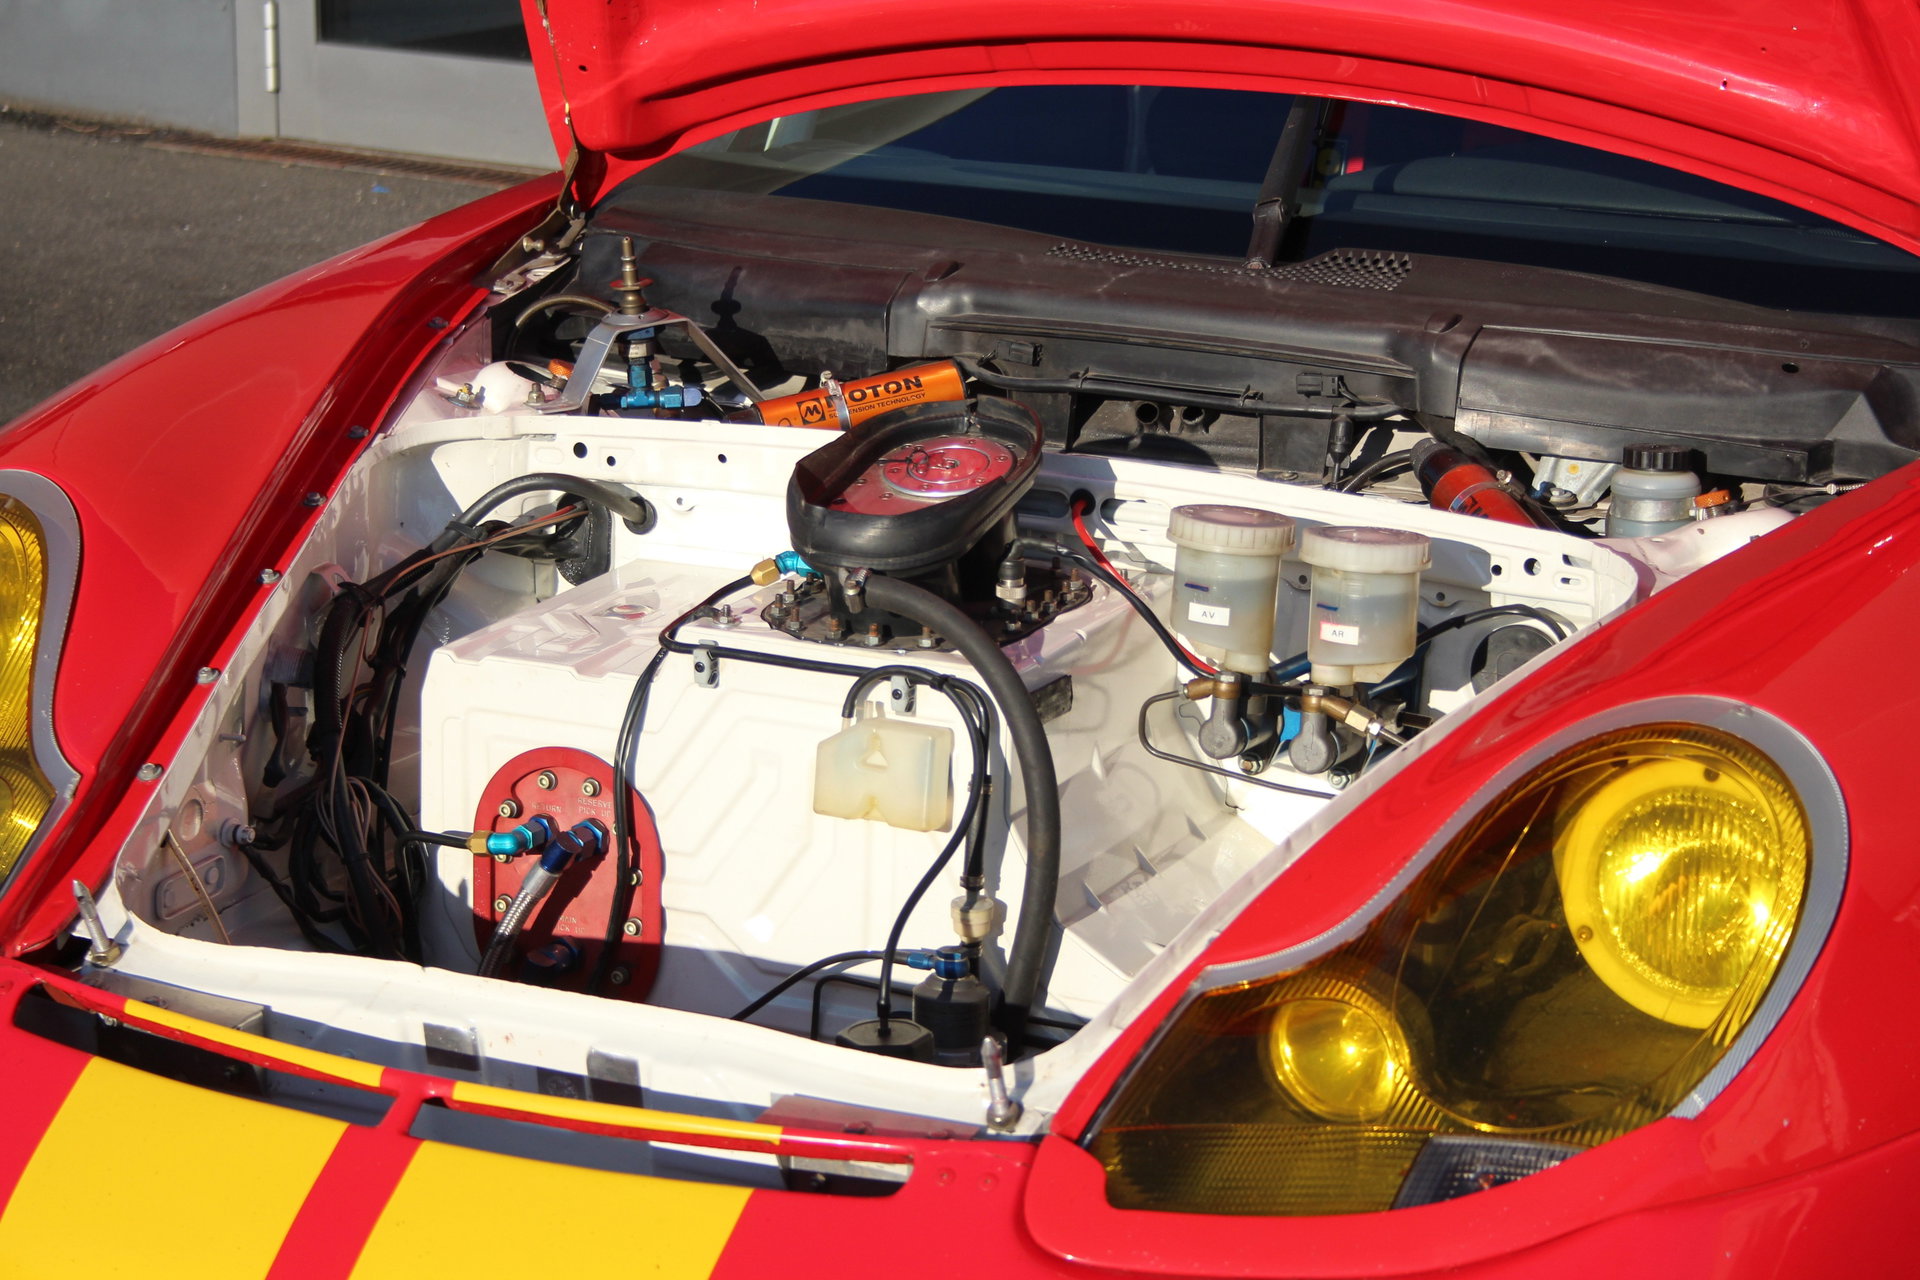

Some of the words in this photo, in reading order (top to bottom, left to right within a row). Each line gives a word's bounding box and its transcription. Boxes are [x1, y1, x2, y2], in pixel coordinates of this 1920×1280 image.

[1201, 611, 1215, 619] AV
[1331, 629, 1344, 638] AR
[532, 801, 562, 813] RETURN
[577, 797, 612, 809] RESERVE
[578, 805, 596, 815] PICK
